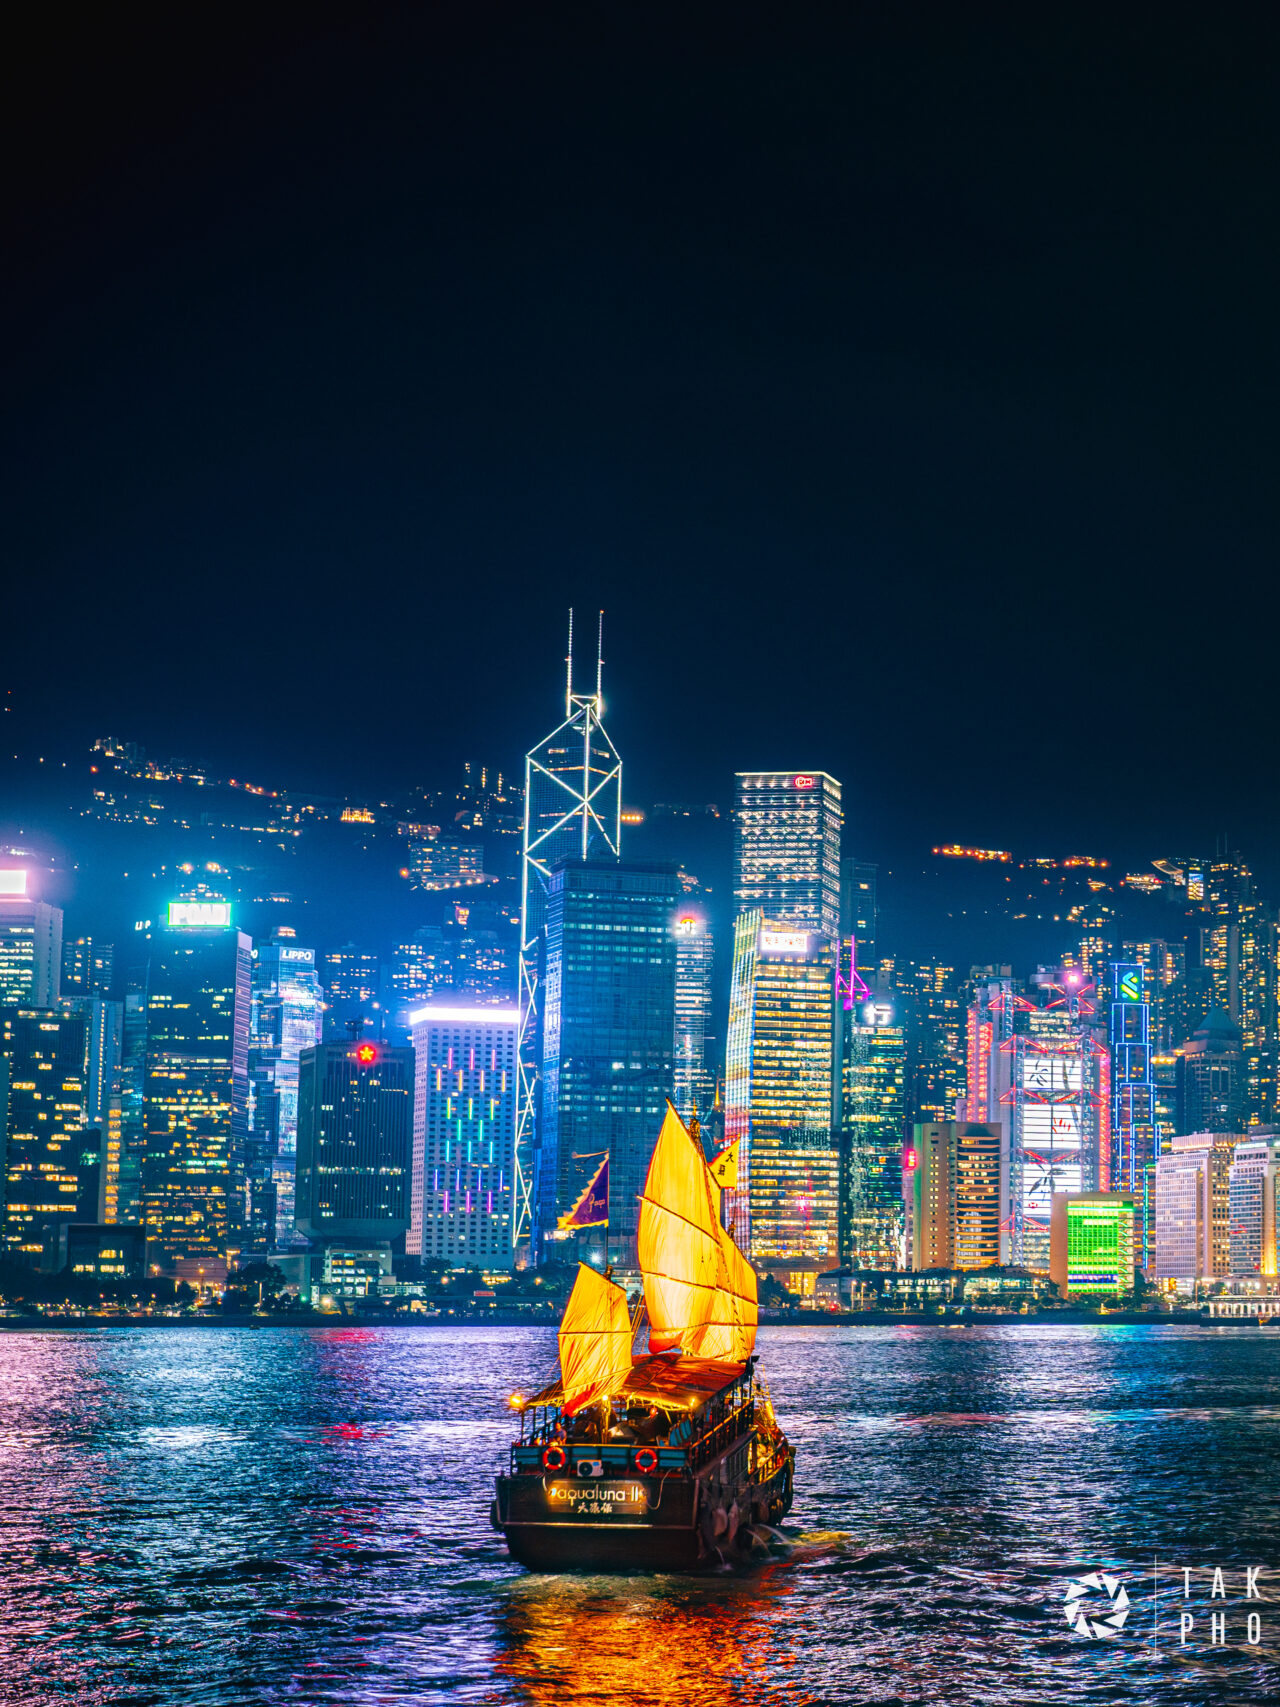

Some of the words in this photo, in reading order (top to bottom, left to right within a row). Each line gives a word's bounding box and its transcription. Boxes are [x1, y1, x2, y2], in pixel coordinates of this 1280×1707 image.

[282, 949, 312, 961] LIPPO
[864, 1003, 891, 1025] 行
[557, 1484, 625, 1506] aqualuna
